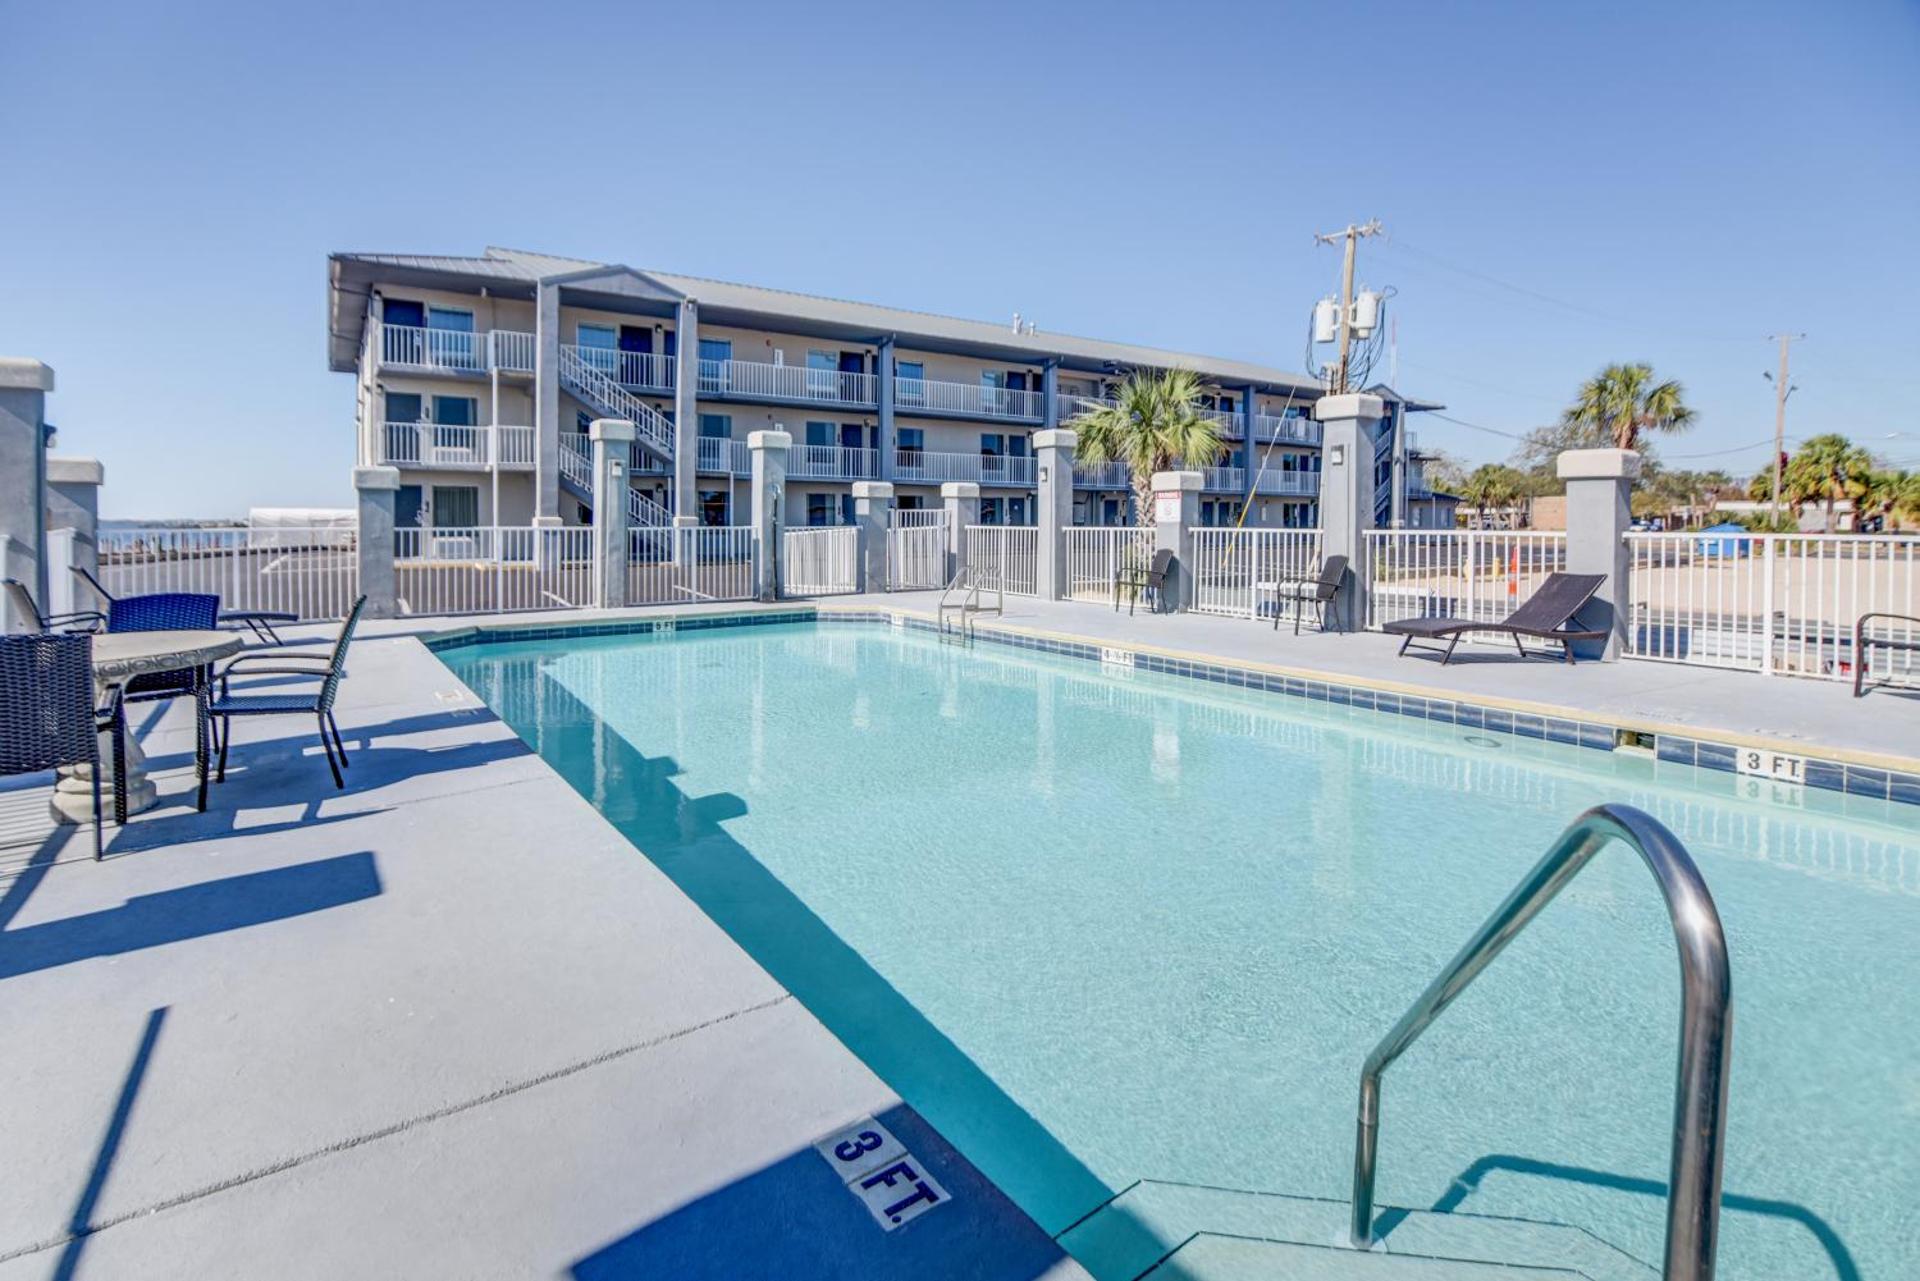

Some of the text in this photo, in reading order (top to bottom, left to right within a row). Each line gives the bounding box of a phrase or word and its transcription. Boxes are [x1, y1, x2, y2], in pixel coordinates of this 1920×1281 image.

[1748, 752, 1800, 778] 3 FT.
[834, 1131, 940, 1223] 3 FT.
